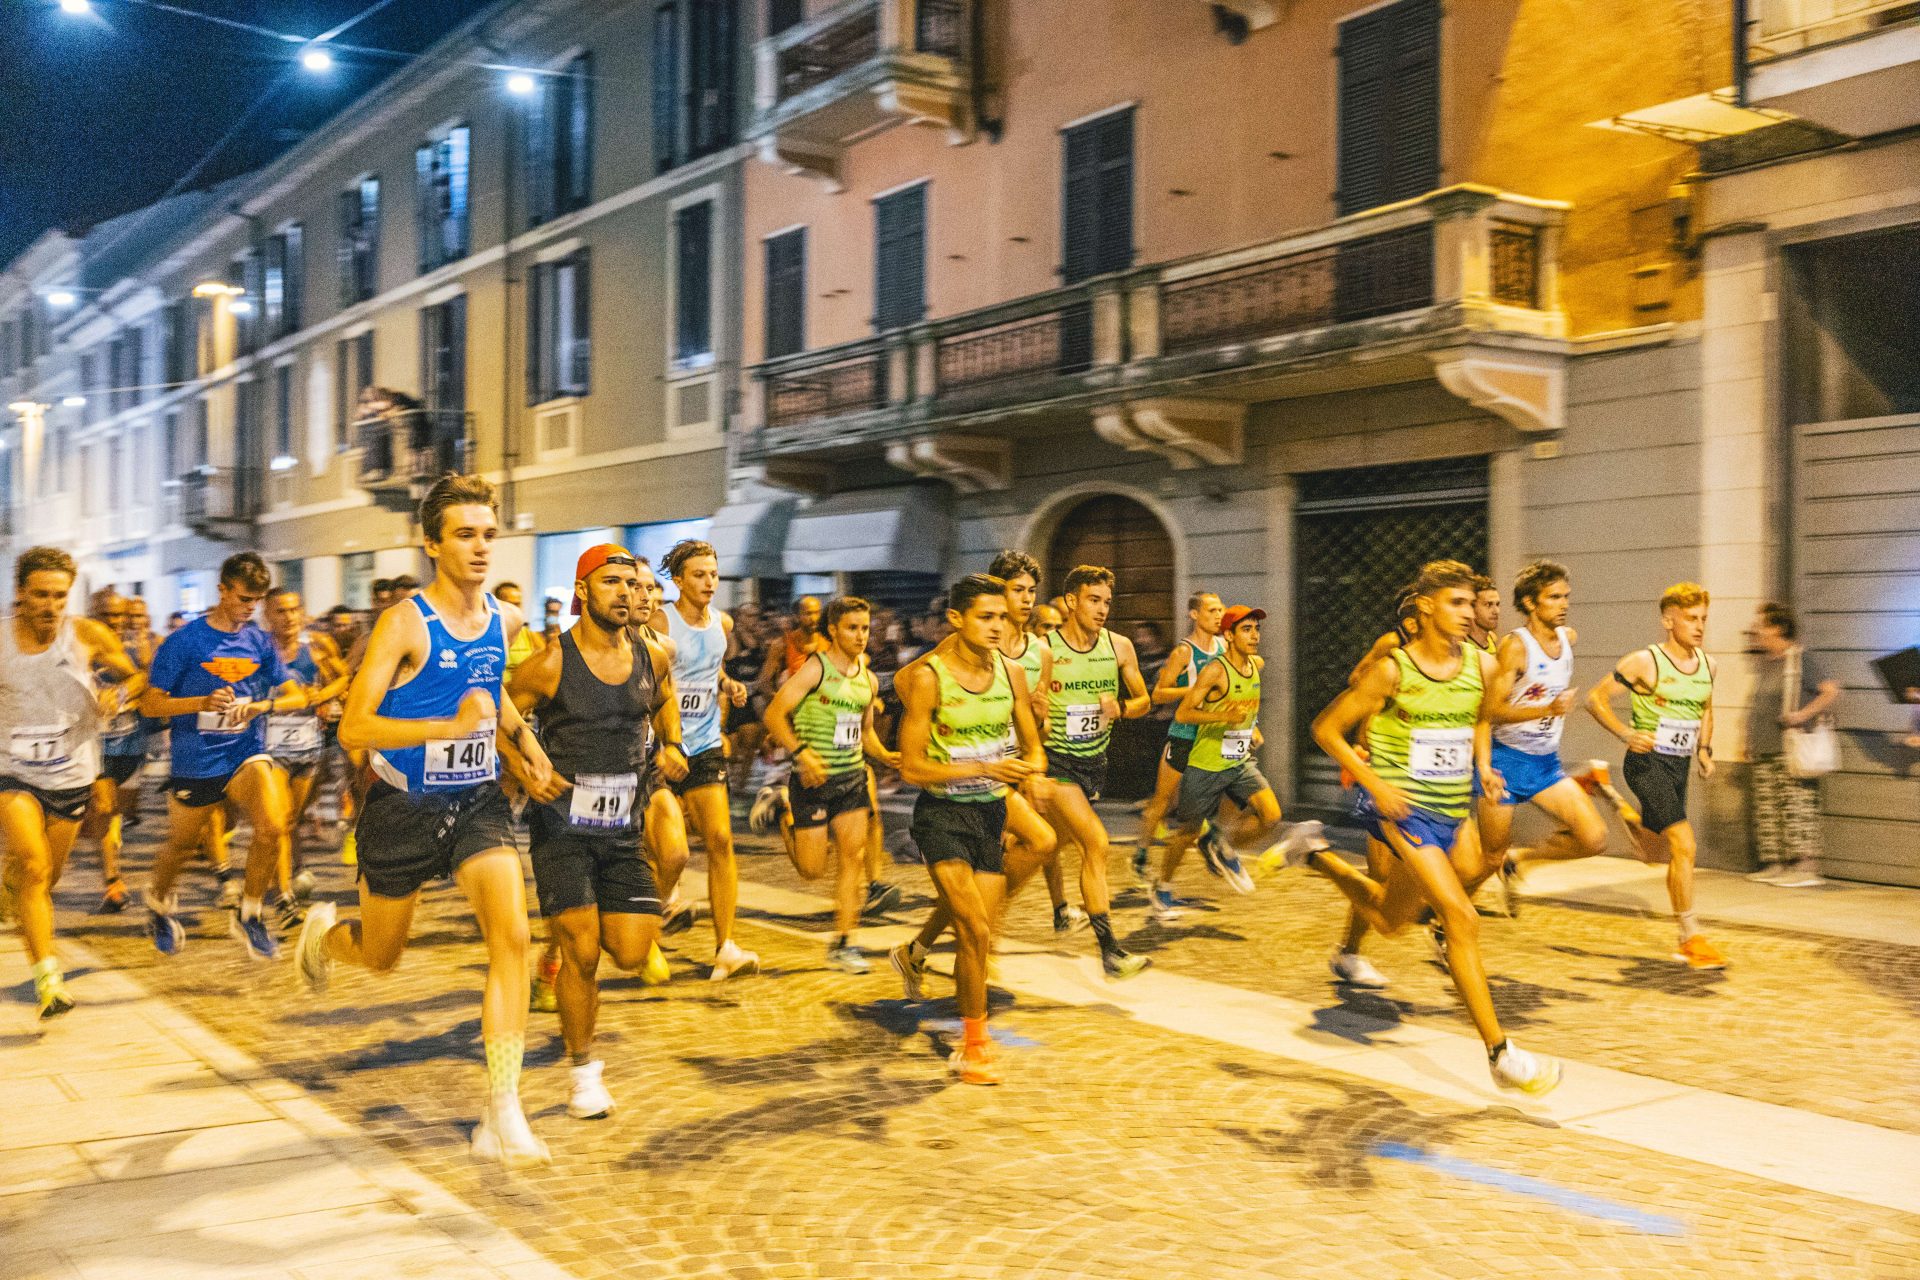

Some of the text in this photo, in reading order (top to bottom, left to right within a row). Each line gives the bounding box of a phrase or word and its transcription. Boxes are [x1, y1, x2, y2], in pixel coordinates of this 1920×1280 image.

[681, 694, 700, 710] 60
[1081, 716, 1100, 732] 25
[1237, 740, 1246, 753] 3
[1670, 733, 1690, 747] 48
[30, 741, 56, 760] 17
[443, 741, 486, 770] 140
